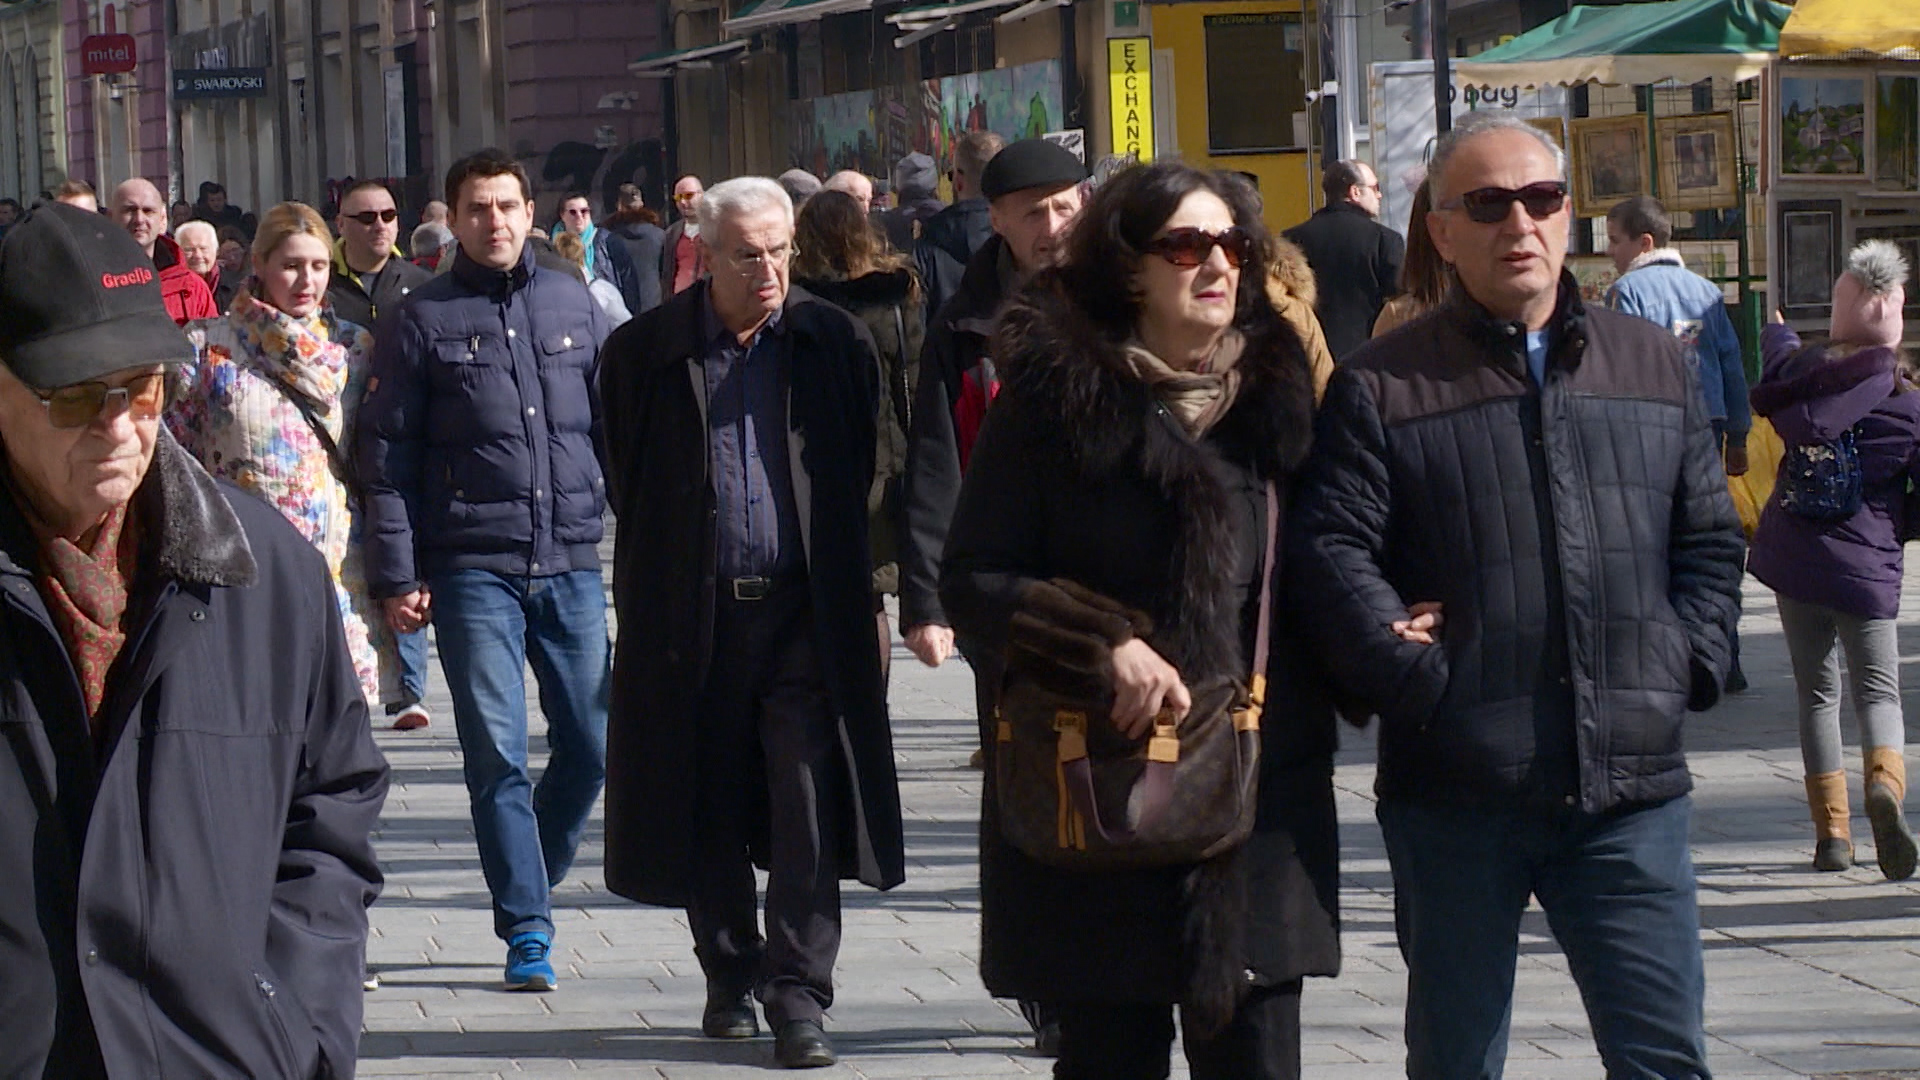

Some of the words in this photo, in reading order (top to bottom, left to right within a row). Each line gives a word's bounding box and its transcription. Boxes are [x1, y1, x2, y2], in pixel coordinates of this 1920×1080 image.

[193, 77, 263, 90] SWAROVSKI
[1123, 43, 1140, 157] EXCHANG
[102, 267, 153, 289] Gracija
